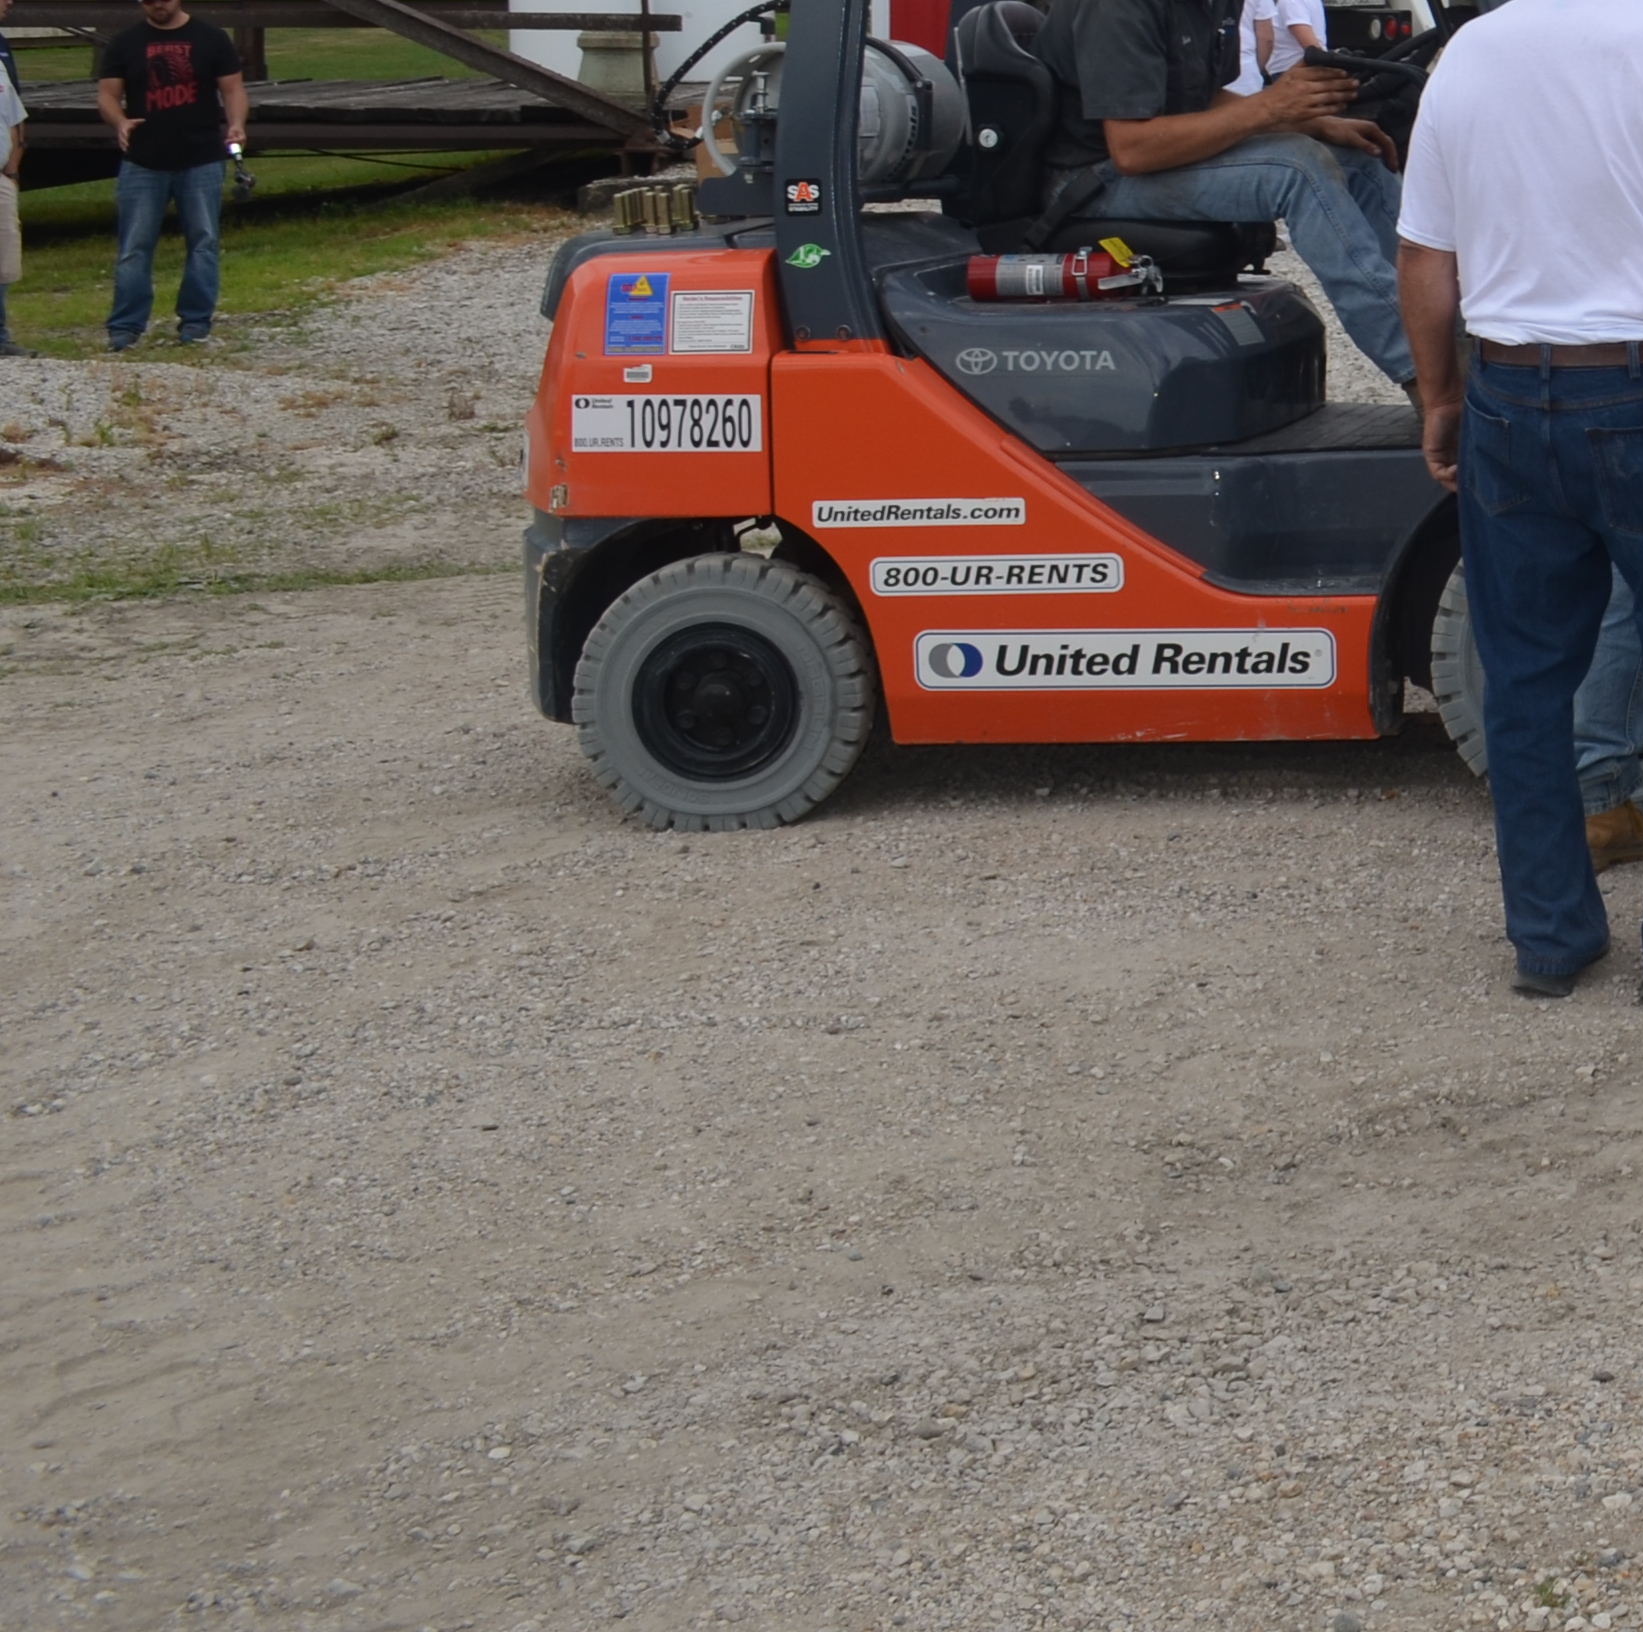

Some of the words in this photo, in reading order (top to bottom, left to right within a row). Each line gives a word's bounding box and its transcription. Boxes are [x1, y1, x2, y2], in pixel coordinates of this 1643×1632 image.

[146, 44, 192, 57] BEAST
[147, 83, 197, 111] MODE
[787, 182, 820, 202] SAS
[1002, 350, 1116, 370] TOYOTA
[626, 399, 752, 449] 10978260
[817, 504, 1020, 522] UnitedRentals.com
[884, 563, 1109, 588] 800-UR-RENTS
[995, 644, 1139, 676] United
[1151, 642, 1311, 676] Rentals
